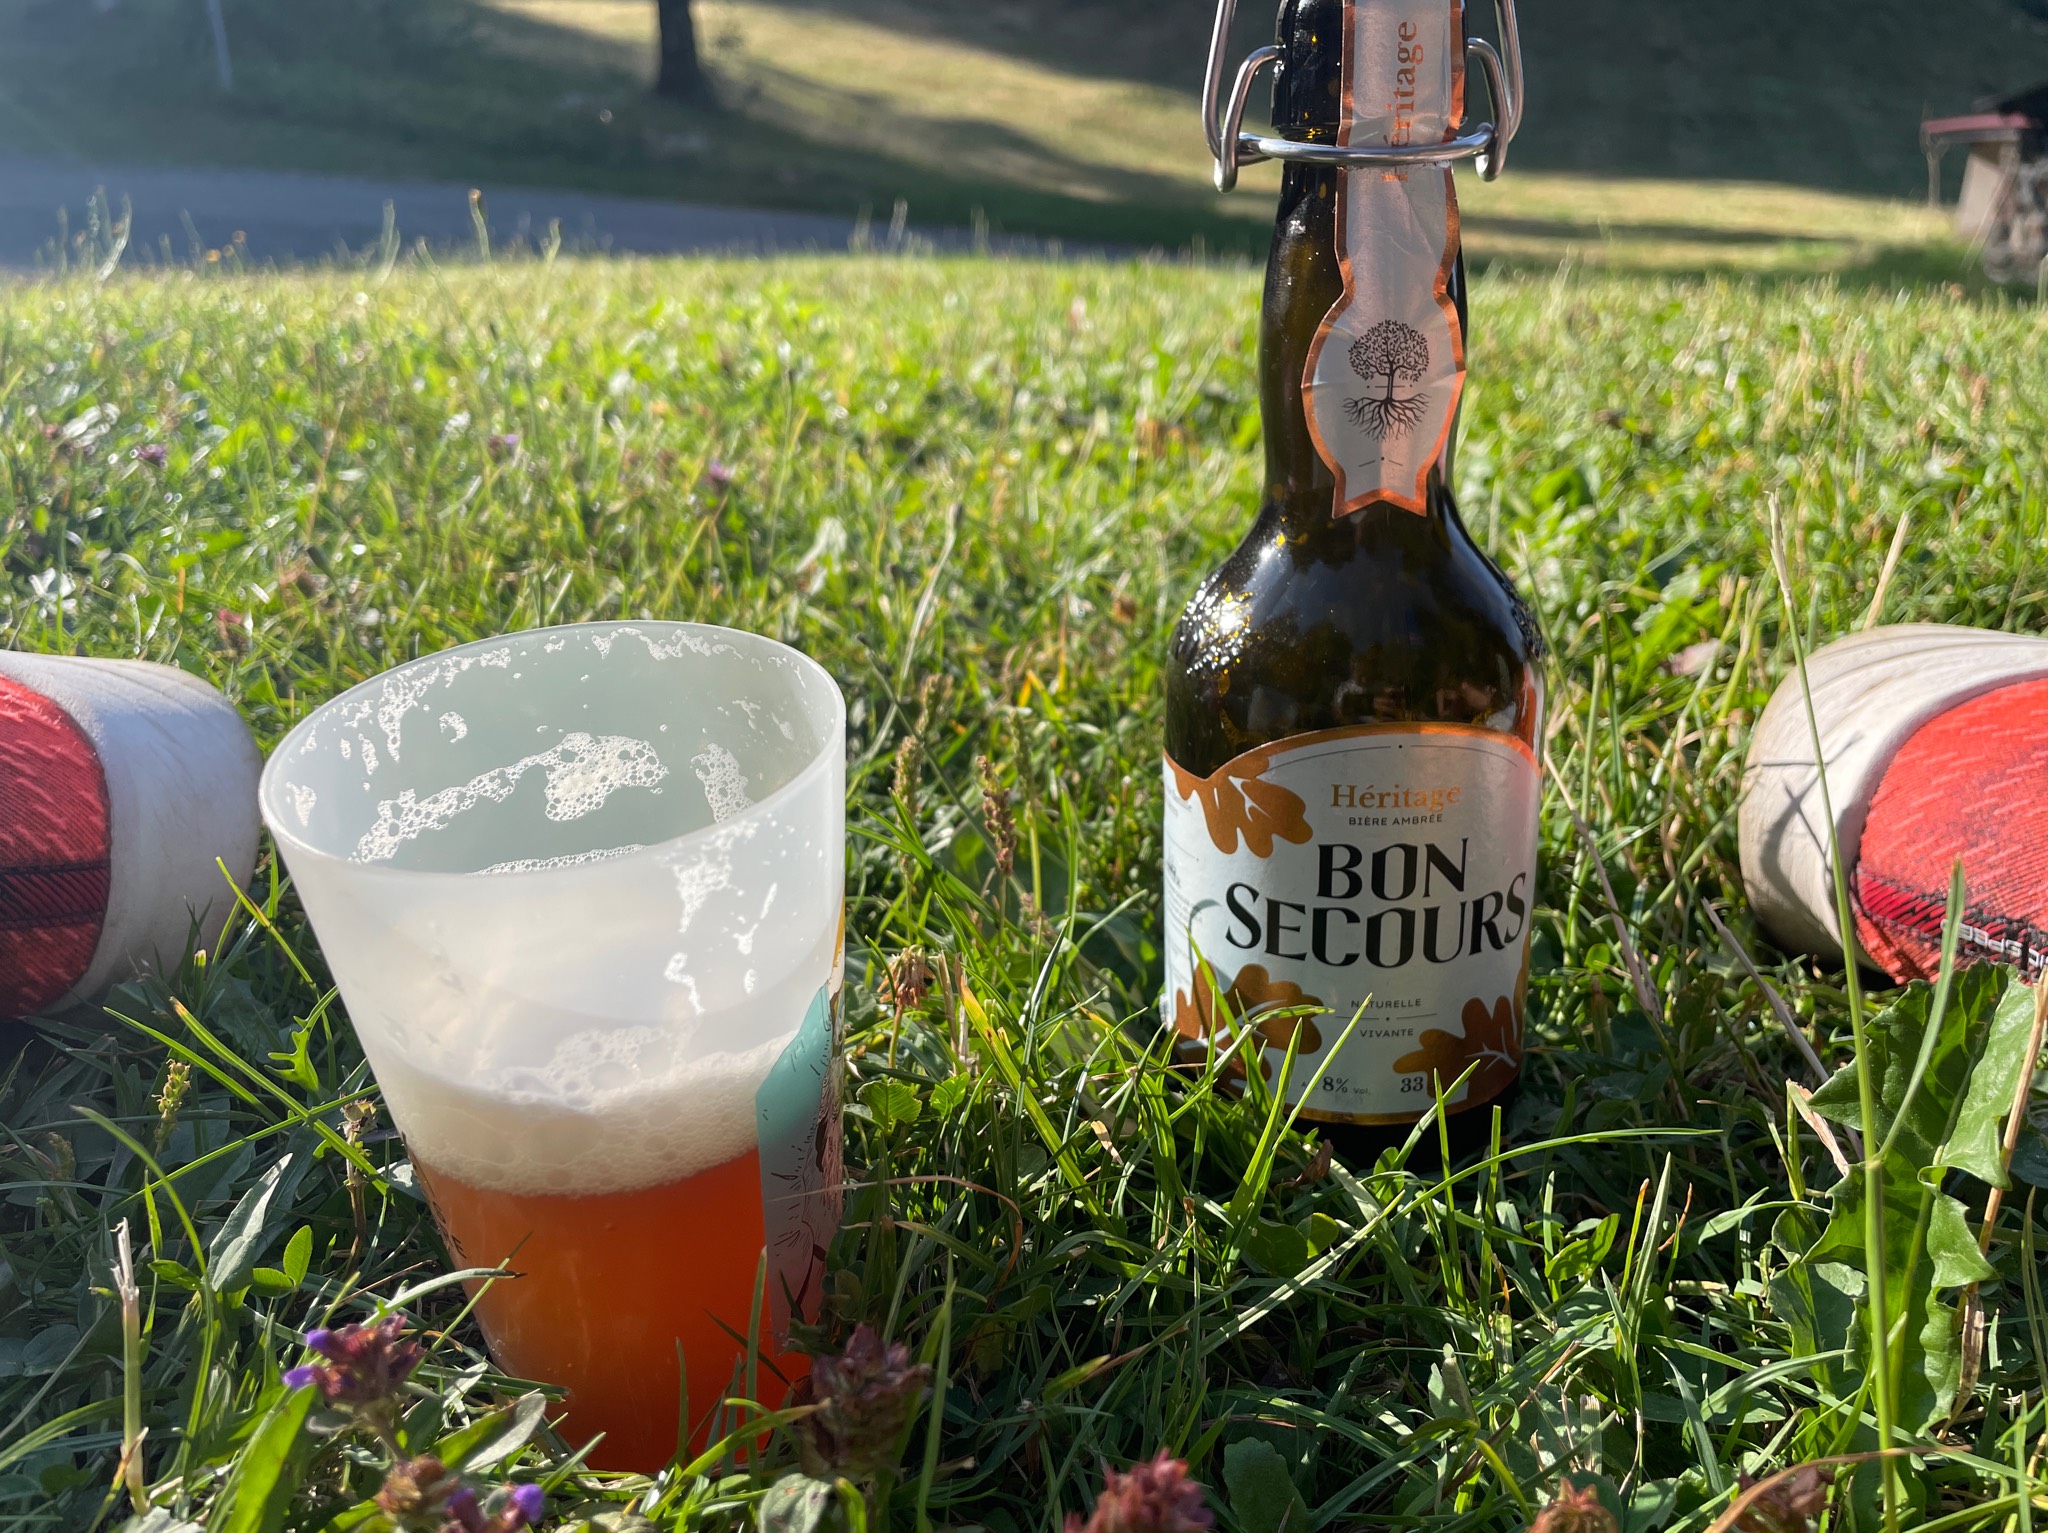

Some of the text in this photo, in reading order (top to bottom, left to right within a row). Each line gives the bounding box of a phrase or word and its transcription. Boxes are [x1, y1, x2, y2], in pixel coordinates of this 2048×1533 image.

[1330, 783, 1462, 813] Héritage
[1348, 813, 1443, 826] BIÈRE AMBRÉE
[1316, 837, 1469, 901] BON
[1225, 871, 1527, 969] SECOURS
[1940, 918, 2022, 958] SPEE
[1350, 998, 1422, 1009] NTURELLE
[1360, 1028, 1414, 1038] VIVANTE
[1322, 1075, 1350, 1093] 8%
[1400, 1076, 1424, 1093] 33
